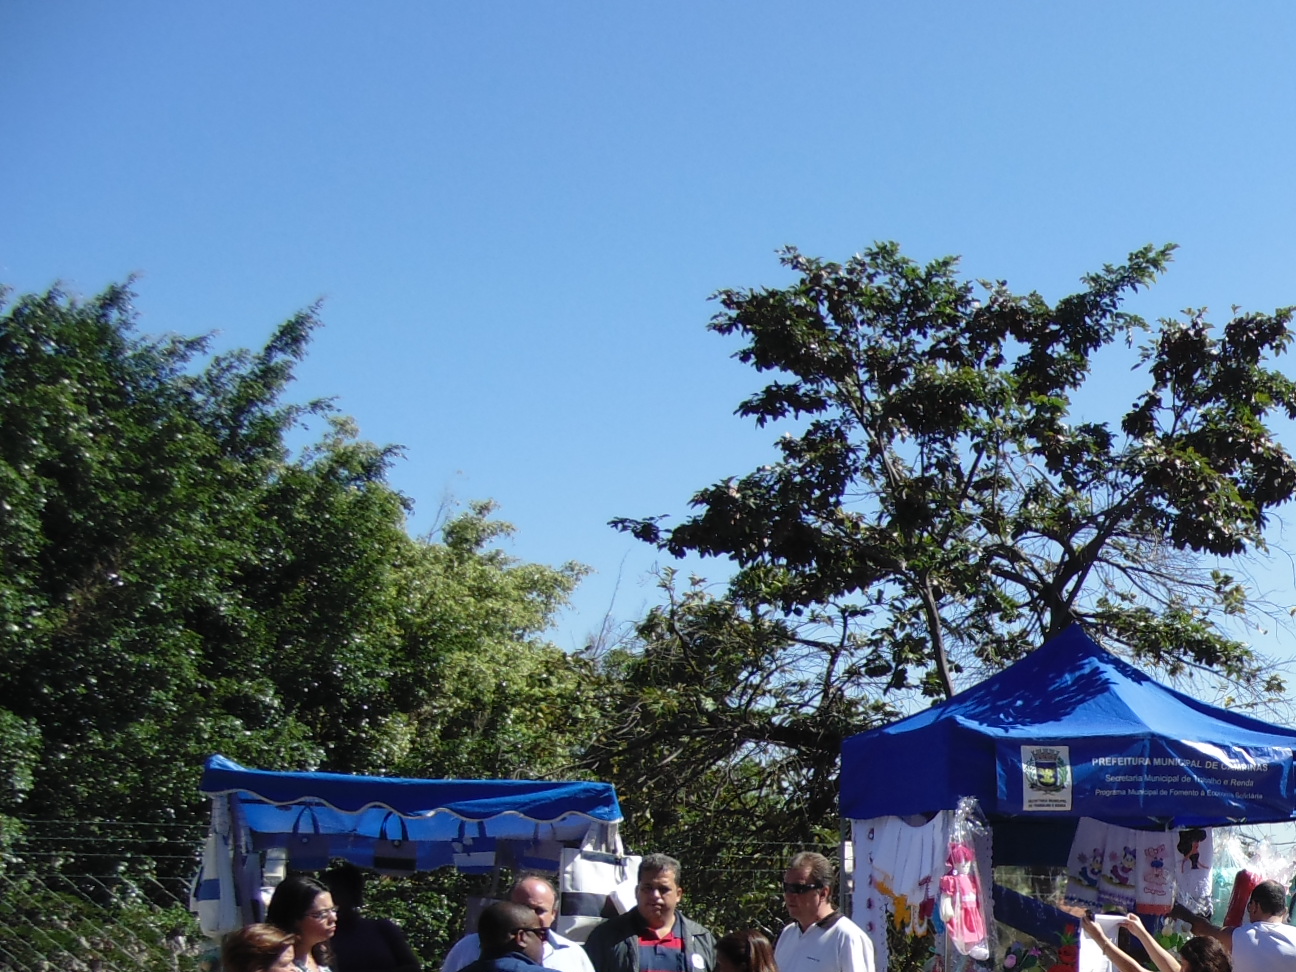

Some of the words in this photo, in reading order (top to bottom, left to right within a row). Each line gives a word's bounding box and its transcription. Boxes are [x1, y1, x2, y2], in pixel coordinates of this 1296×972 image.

[1092, 757, 1151, 766] PREFEITURA
[1153, 758, 1203, 768] MUNICIPAL
[1205, 760, 1219, 770] DE
[1105, 774, 1143, 782] Secretaria
[1144, 774, 1180, 783] Municipal
[1181, 775, 1192, 783] de
[1230, 778, 1254, 787] Renda
[1095, 788, 1126, 797] Programa
[1159, 788, 1168, 796] de
[1169, 788, 1199, 796] Fomento
